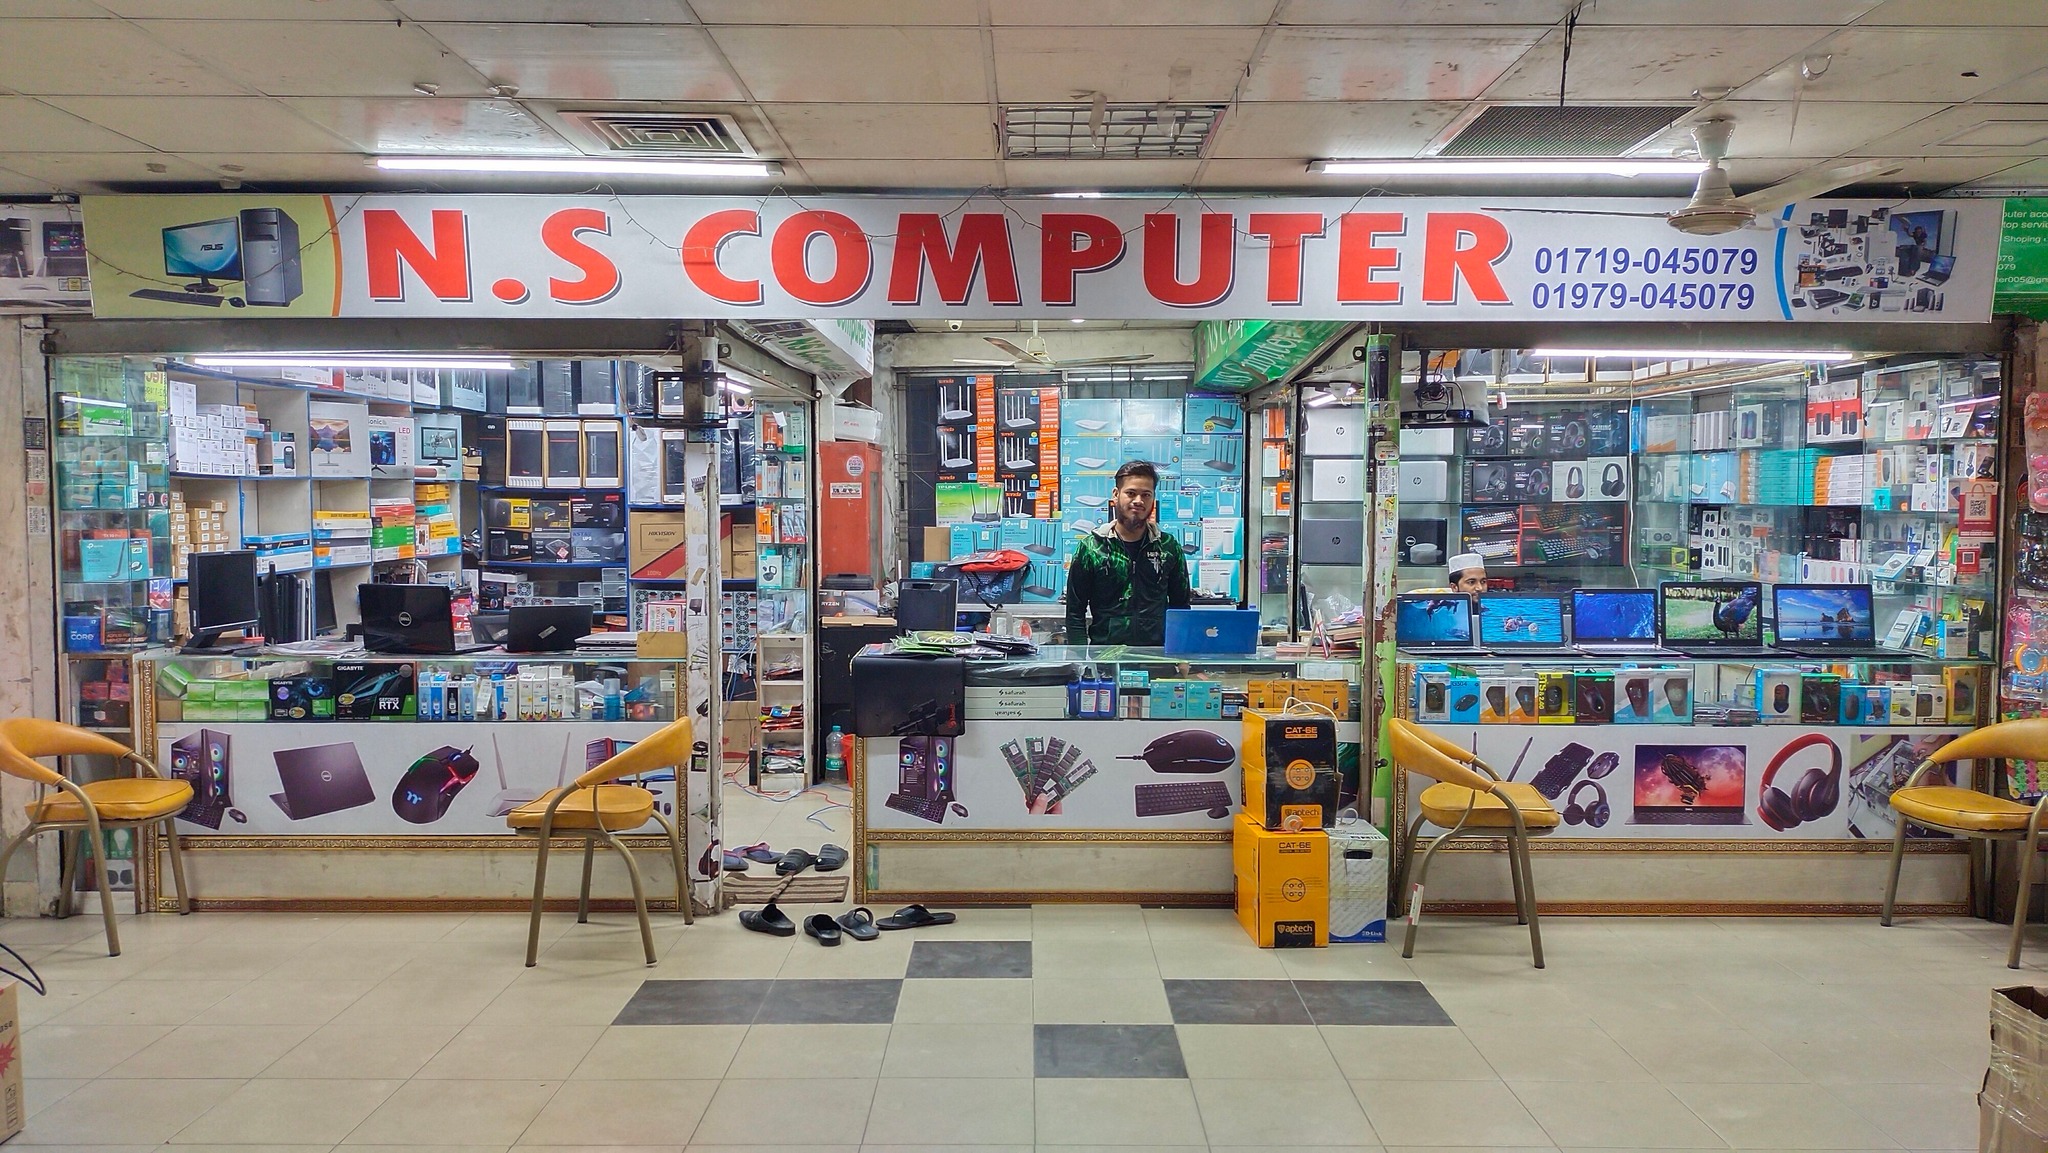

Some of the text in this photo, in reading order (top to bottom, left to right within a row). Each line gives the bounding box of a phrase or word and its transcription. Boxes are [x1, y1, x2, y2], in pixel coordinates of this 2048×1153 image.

[2003, 235, 2041, 244] Shoping
[200, 243, 224, 252] ASUS
[365, 208, 1514, 306] N.S COMPUTER
[1534, 247, 1758, 275] 01719-045079
[1531, 282, 1756, 310] 01979-045079
[1463, 470, 1471, 498] HAVIT
[70, 633, 94, 641] CORE
[378, 701, 399, 710] RTX
[1285, 726, 1318, 734] CAT-6E
[1292, 808, 1319, 818] aptech
[1285, 924, 1312, 933] aptech
